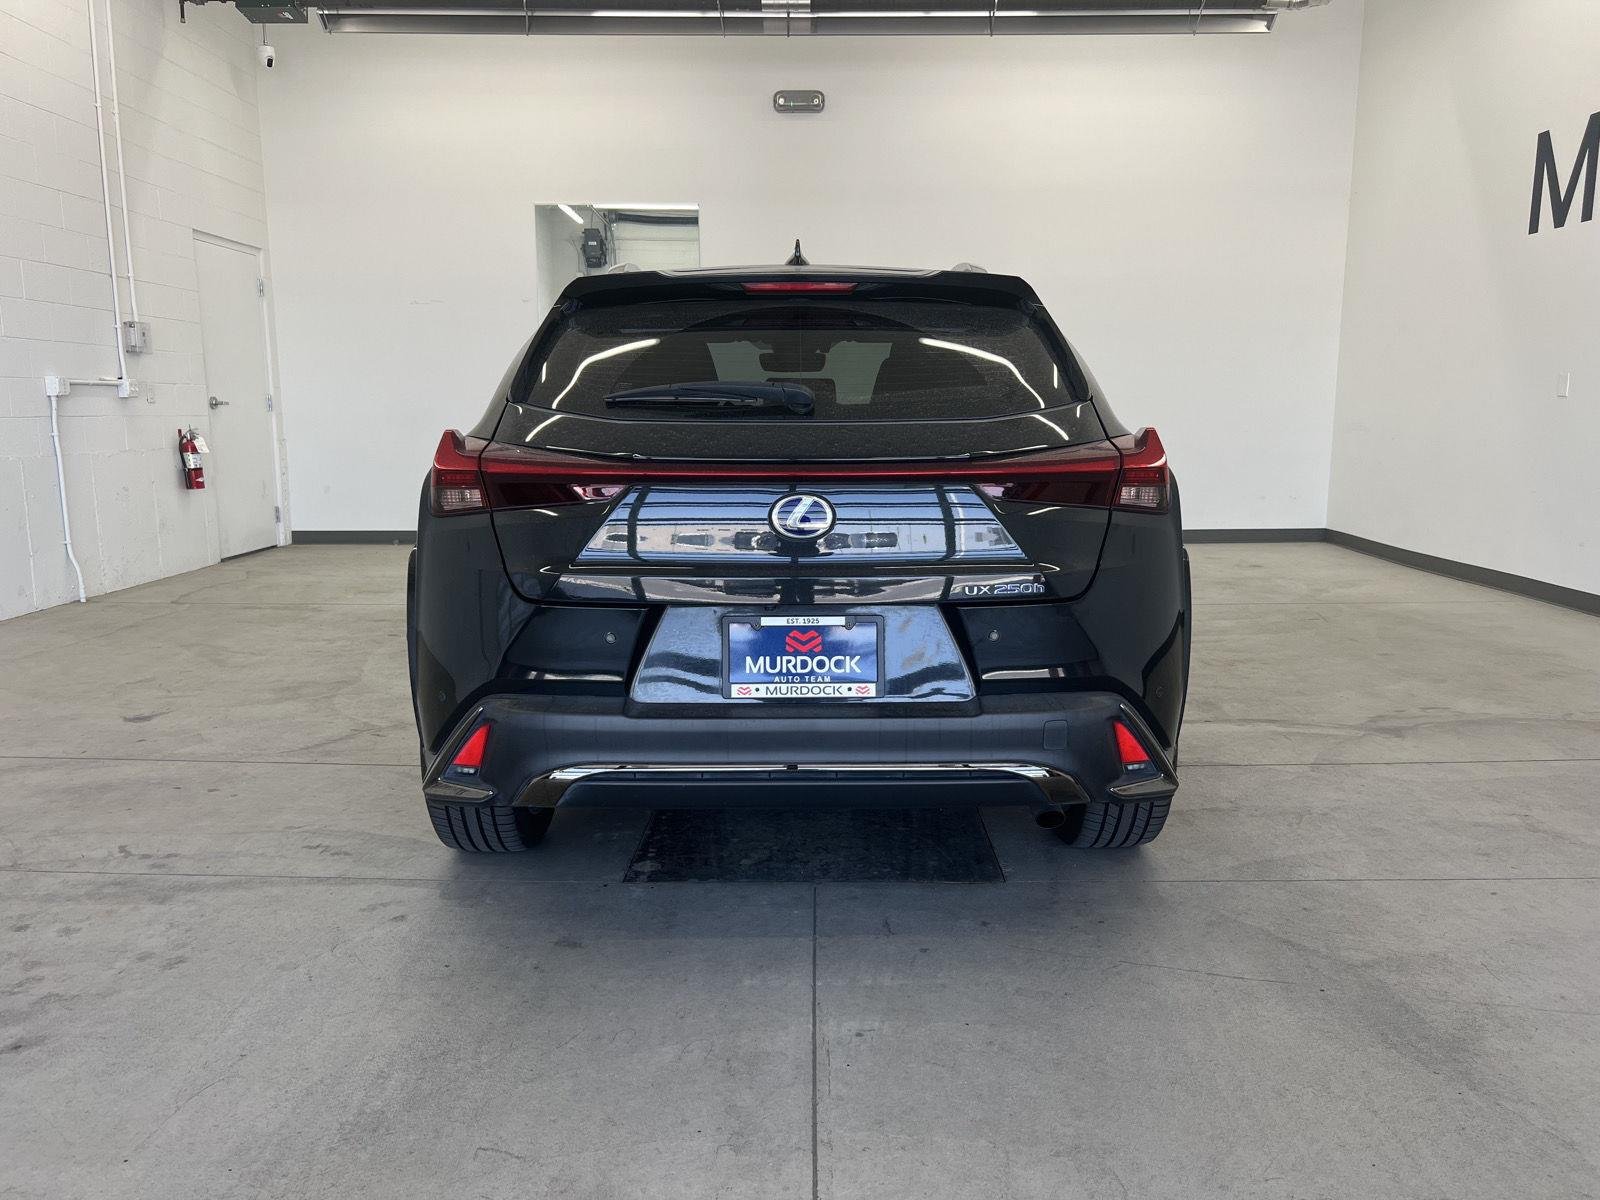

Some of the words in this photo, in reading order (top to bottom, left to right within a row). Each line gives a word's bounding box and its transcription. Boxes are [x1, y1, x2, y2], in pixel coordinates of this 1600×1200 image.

[964, 585, 991, 596] UX
[994, 583, 1045, 595] 250h
[786, 617, 801, 625] EST.
[802, 617, 820, 625] 1925
[745, 655, 861, 674] MURDOCK
[774, 675, 800, 683] AUTO
[804, 675, 831, 683] TEAM
[765, 685, 843, 696] MURDOCK
